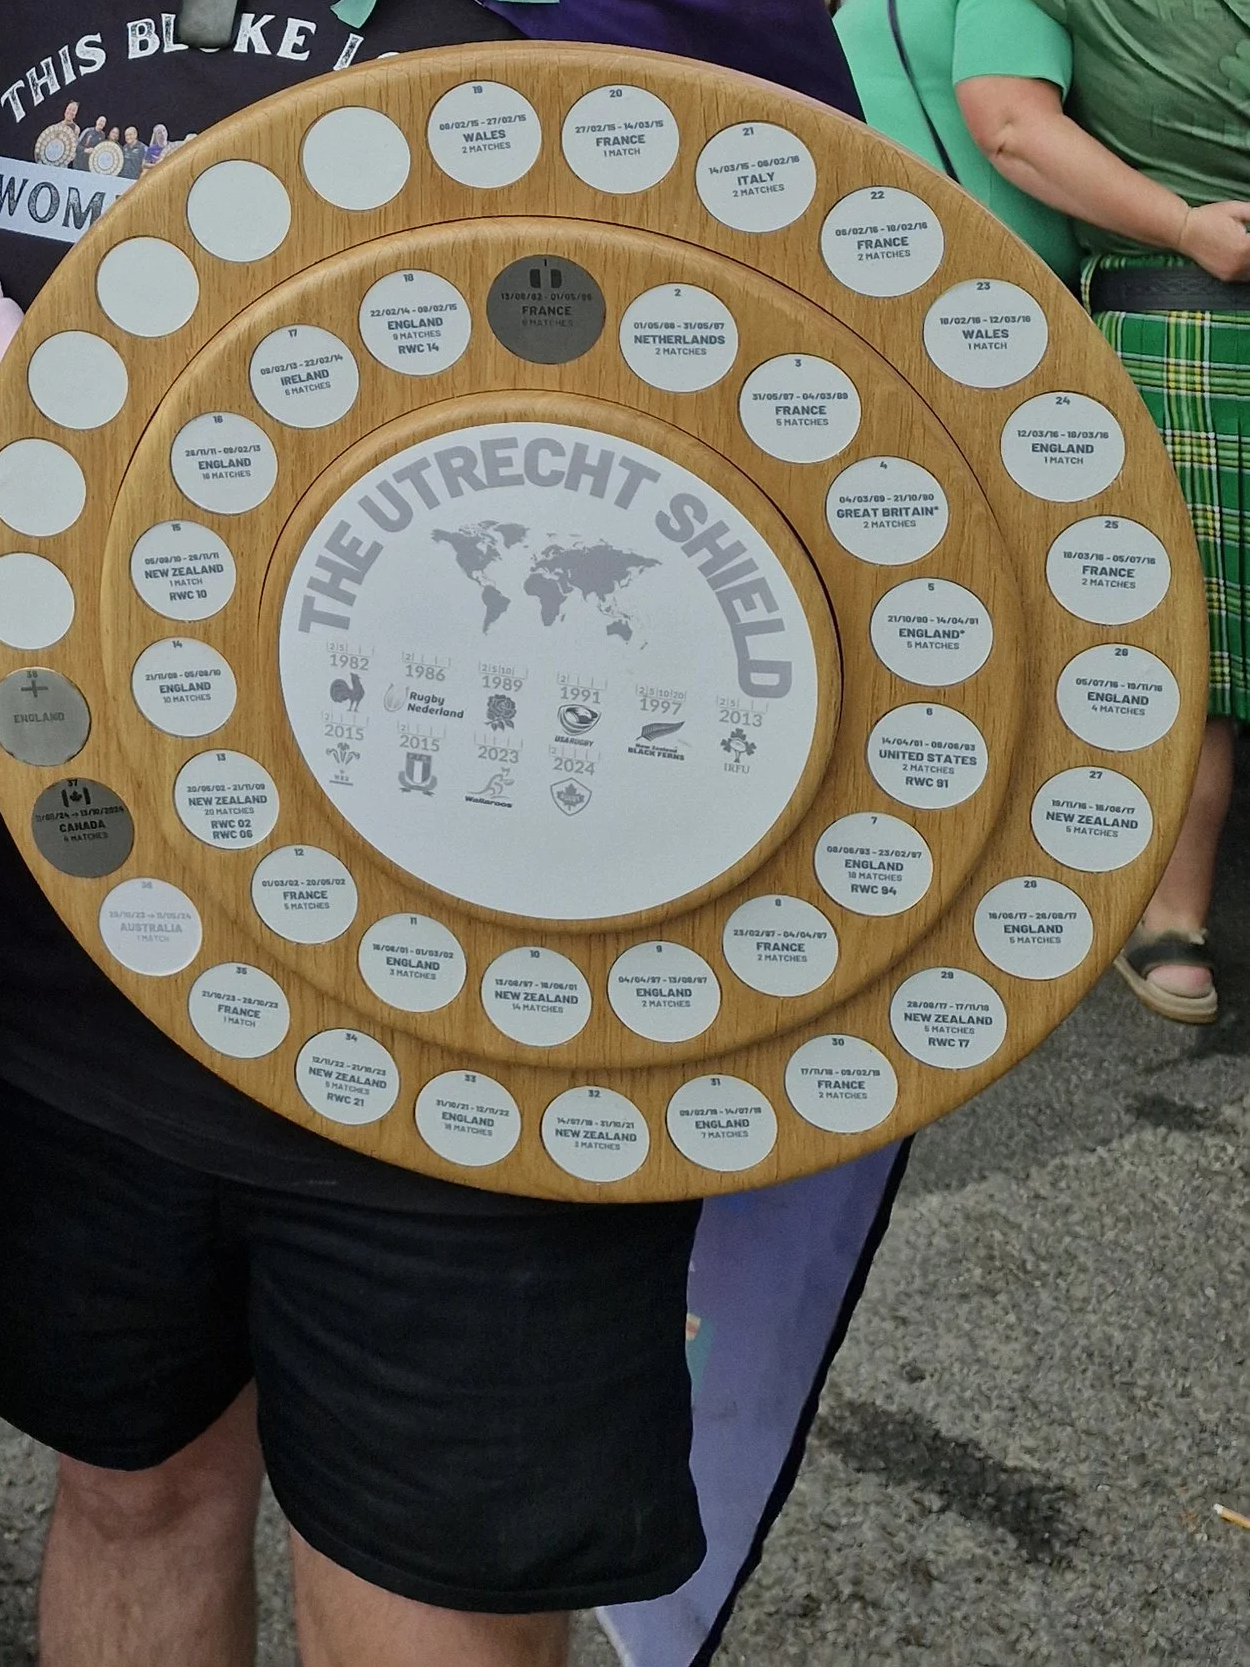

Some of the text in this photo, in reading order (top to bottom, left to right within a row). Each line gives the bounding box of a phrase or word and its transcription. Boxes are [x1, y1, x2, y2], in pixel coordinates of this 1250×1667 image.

[0, 32, 108, 124] THIS
[126, 12, 318, 62] BLKE
[608, 88, 623, 99] 20
[462, 128, 507, 143] WALES
[742, 126, 755, 137] 21
[595, 134, 646, 148] FRANCE
[603, 147, 641, 158] 1 MATCH
[736, 171, 775, 186] ITALY
[732, 183, 786, 198] 2 MATCHES
[870, 190, 886, 200] 22
[856, 236, 910, 251] FRANCE
[857, 249, 911, 262] 2 MATCHES
[674, 288, 682, 297] 2
[976, 282, 991, 291] 23
[522, 305, 572, 316] FRANCE
[387, 316, 444, 331] ENGLAND
[288, 330, 298, 338] 17
[633, 334, 726, 346] NETHERLANDS
[961, 328, 1010, 340] WALES
[397, 342, 440, 355] RWC 14
[654, 347, 707, 356] 2 MATCHES
[968, 341, 1008, 351] 1 MATCH
[794, 358, 802, 368] 3
[280, 368, 330, 387] IRELAND
[1055, 396, 1071, 406] 24
[774, 404, 828, 416] FRANCE
[1031, 442, 1095, 454] ENGLAND
[197, 457, 252, 471] ENGLAND
[879, 460, 888, 470] 4
[836, 507, 880, 519] GREAT
[1104, 519, 1119, 530] 25
[144, 563, 224, 580] NEW ZEALAND
[298, 436, 793, 699] THE UTRECHT SHIELD
[1082, 564, 1136, 579] FRANCE
[927, 582, 935, 592] 5
[168, 589, 208, 602] RWC 10
[329, 653, 369, 671] 1982
[405, 664, 446, 682] 1986
[158, 681, 212, 694] ENGLAND
[481, 675, 523, 693] 1989
[409, 690, 445, 706] Rugby
[560, 686, 601, 705] 1991
[1087, 691, 1150, 706] ENGLAND
[407, 703, 465, 720] Nederland
[639, 697, 682, 716] 1997
[719, 709, 763, 728] 2013
[323, 724, 365, 741] 2015
[399, 734, 440, 752] 2015
[477, 745, 519, 764] 2023
[627, 747, 656, 757] BLACK
[878, 749, 978, 766] UNITED STATES
[553, 757, 596, 776] 2024
[1088, 770, 1104, 780] 27
[905, 776, 934, 788] RWC
[188, 794, 268, 807] NEW ZEALAND
[464, 795, 513, 809] Wallaroos
[58, 819, 106, 834] CANADA
[210, 818, 252, 830] RWC 02
[870, 816, 878, 825] 7
[1045, 810, 1139, 830] NEW ZEALAND
[212, 829, 239, 840] RWC
[293, 848, 305, 857] 12
[844, 858, 904, 872] ENGLAND
[282, 890, 329, 901] FRANCE
[850, 883, 879, 895] RWC
[1003, 924, 1064, 934] ENGLAND
[756, 941, 806, 953] FRANCE
[385, 956, 440, 971] ENGLAND
[494, 990, 579, 1005] NEW ZEALAND
[635, 987, 693, 998] ENGLAND
[217, 1003, 262, 1020] FRANCE
[903, 1012, 994, 1026] NEW ZEALAND
[928, 1036, 970, 1048] RWC 17
[308, 1066, 388, 1090] NEW ZEALAND
[817, 1079, 866, 1090] FRANCE
[326, 1092, 365, 1108] RWC 21
[441, 1111, 495, 1128] ENGLAND
[694, 1118, 750, 1130] ENGLAND
[554, 1128, 638, 1142] NEW ZEALAND
